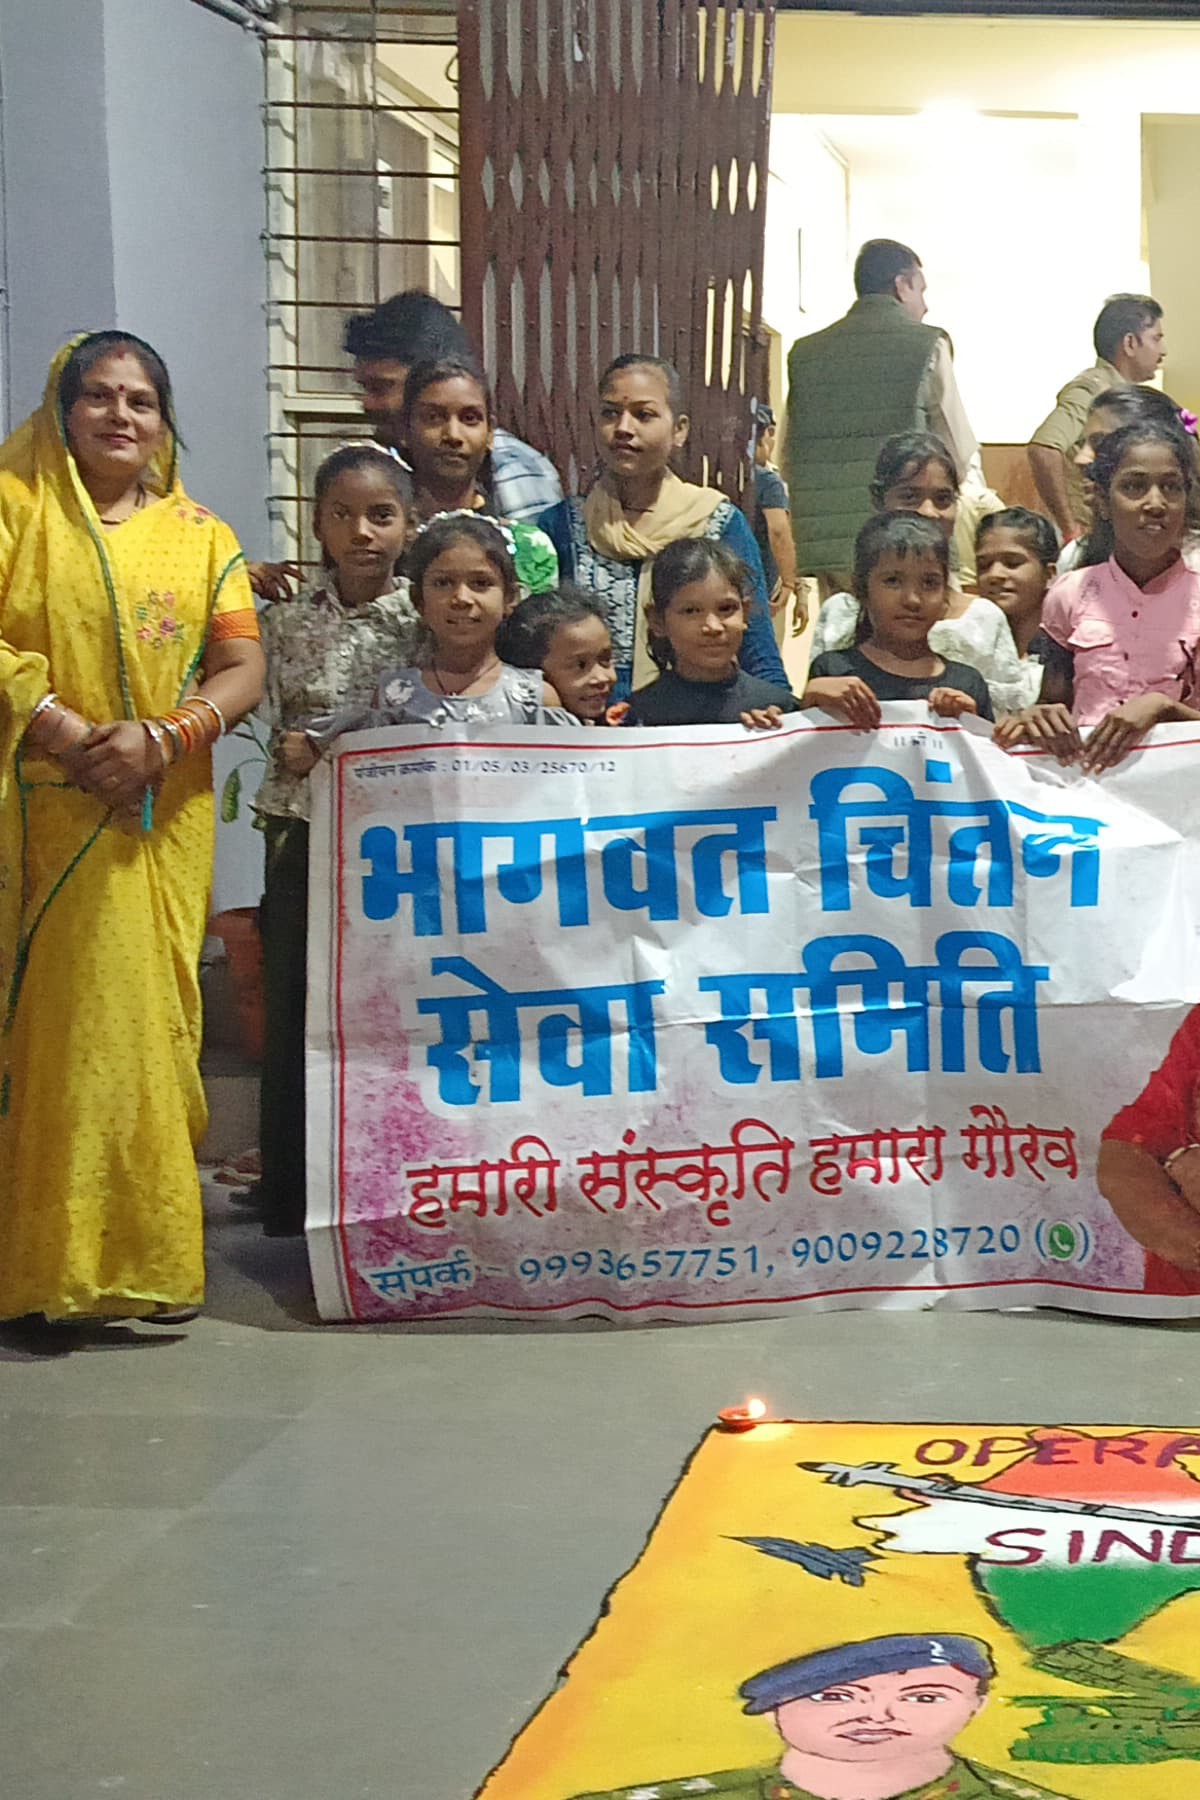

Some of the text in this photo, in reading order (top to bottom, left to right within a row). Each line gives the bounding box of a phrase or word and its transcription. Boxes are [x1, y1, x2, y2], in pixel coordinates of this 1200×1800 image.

[361, 759, 1110, 936] भागवत चिंतन
[416, 930, 1050, 1105] सेवा समिति
[406, 1106, 1077, 1228] हमारी संस्कृति हमारा गौरव
[371, 1249, 472, 1297] संपर्क
[792, 1224, 1020, 1268] 9009228720
